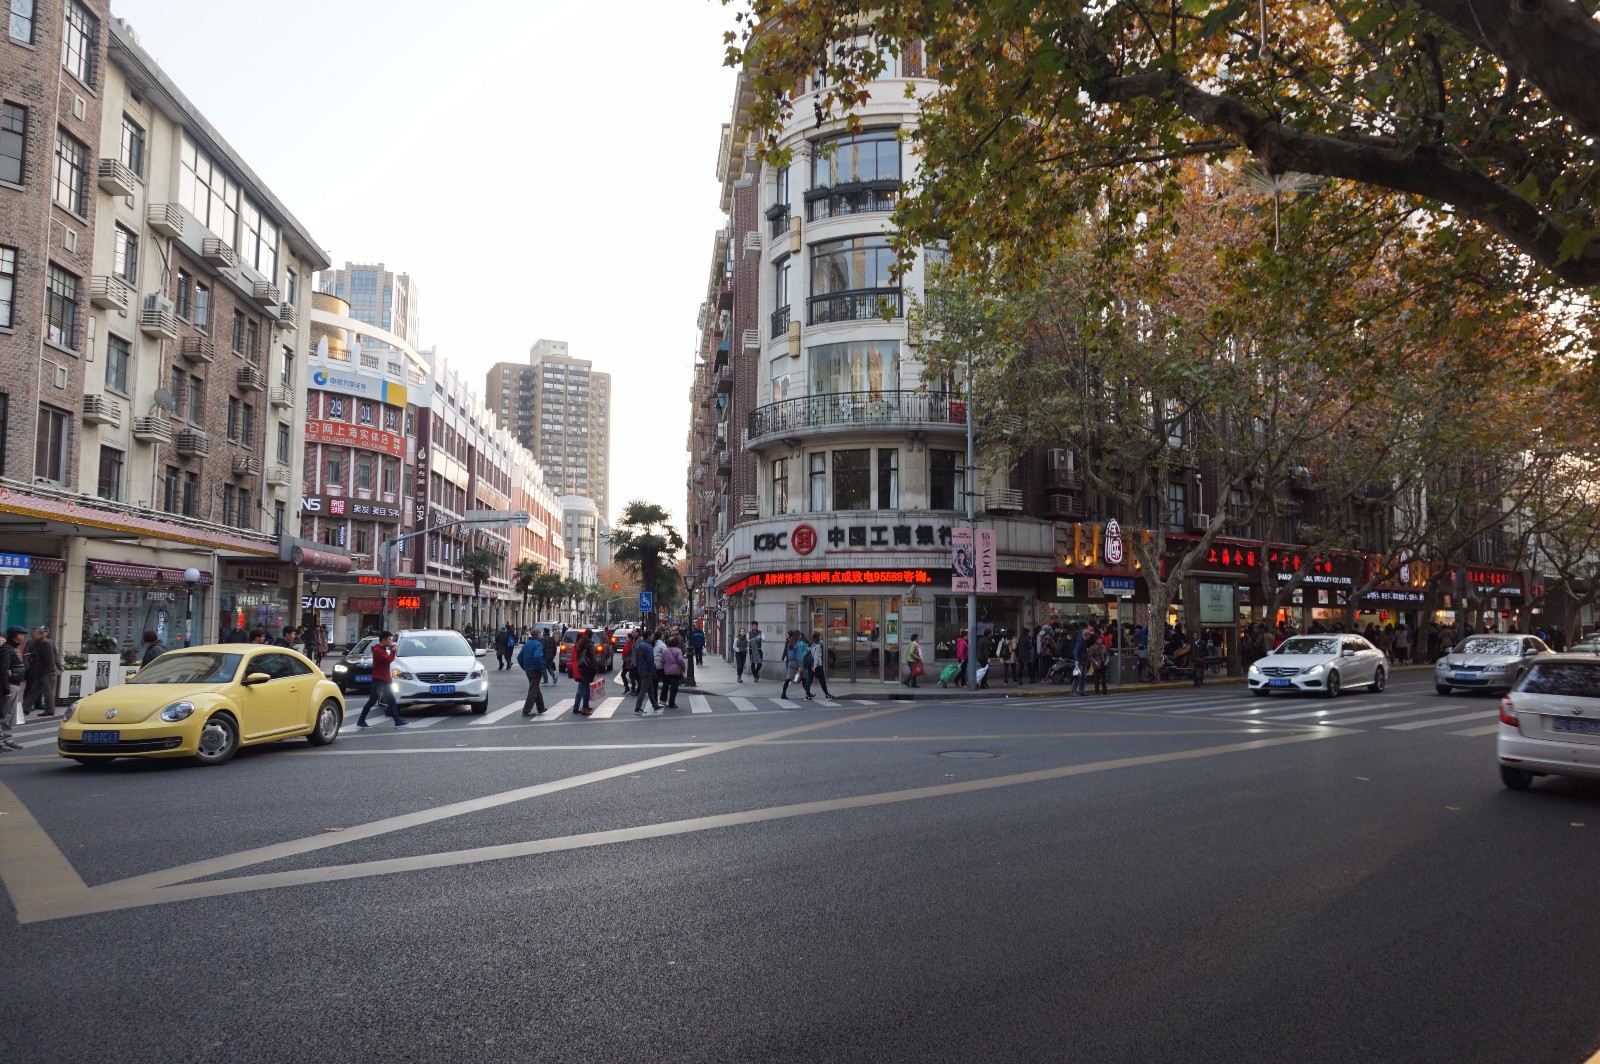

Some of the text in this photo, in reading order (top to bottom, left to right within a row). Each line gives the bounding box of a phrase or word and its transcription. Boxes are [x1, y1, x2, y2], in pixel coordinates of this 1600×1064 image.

[753, 532, 788, 551] ICBC
[827, 524, 952, 548] 中国工商银行
[982, 548, 992, 590] VOGUE
